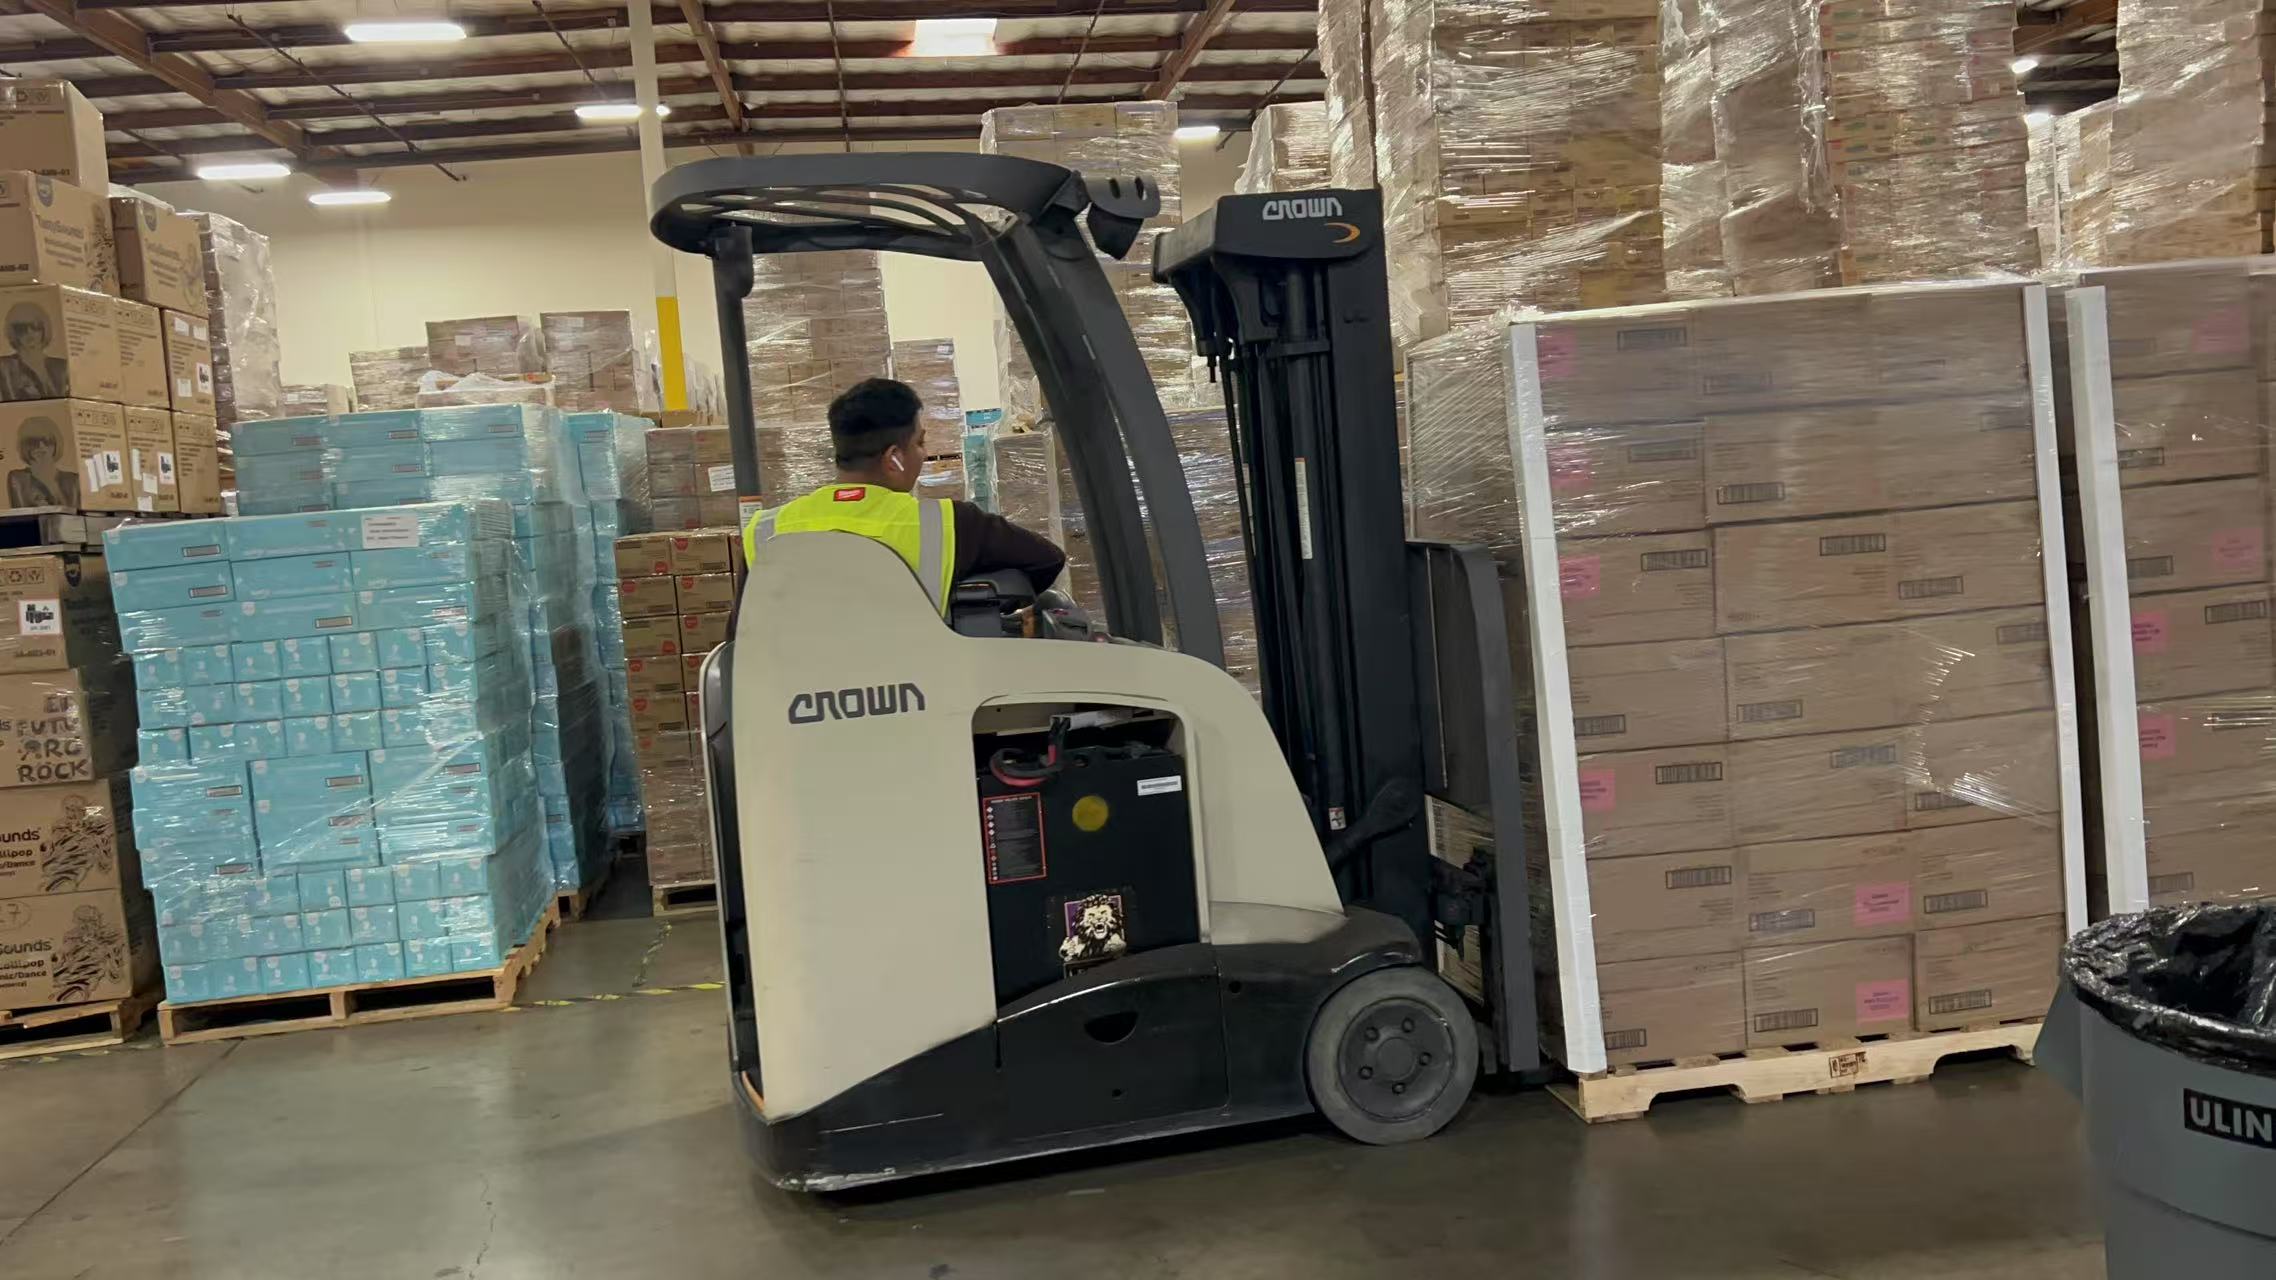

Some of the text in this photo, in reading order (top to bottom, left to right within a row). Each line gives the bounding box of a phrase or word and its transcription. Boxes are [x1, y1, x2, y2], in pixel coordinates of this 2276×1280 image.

[1262, 197, 1343, 220] CROWN
[788, 682, 925, 725] CROWN
[17, 759, 89, 782] ROCK
[0, 829, 40, 843] unds
